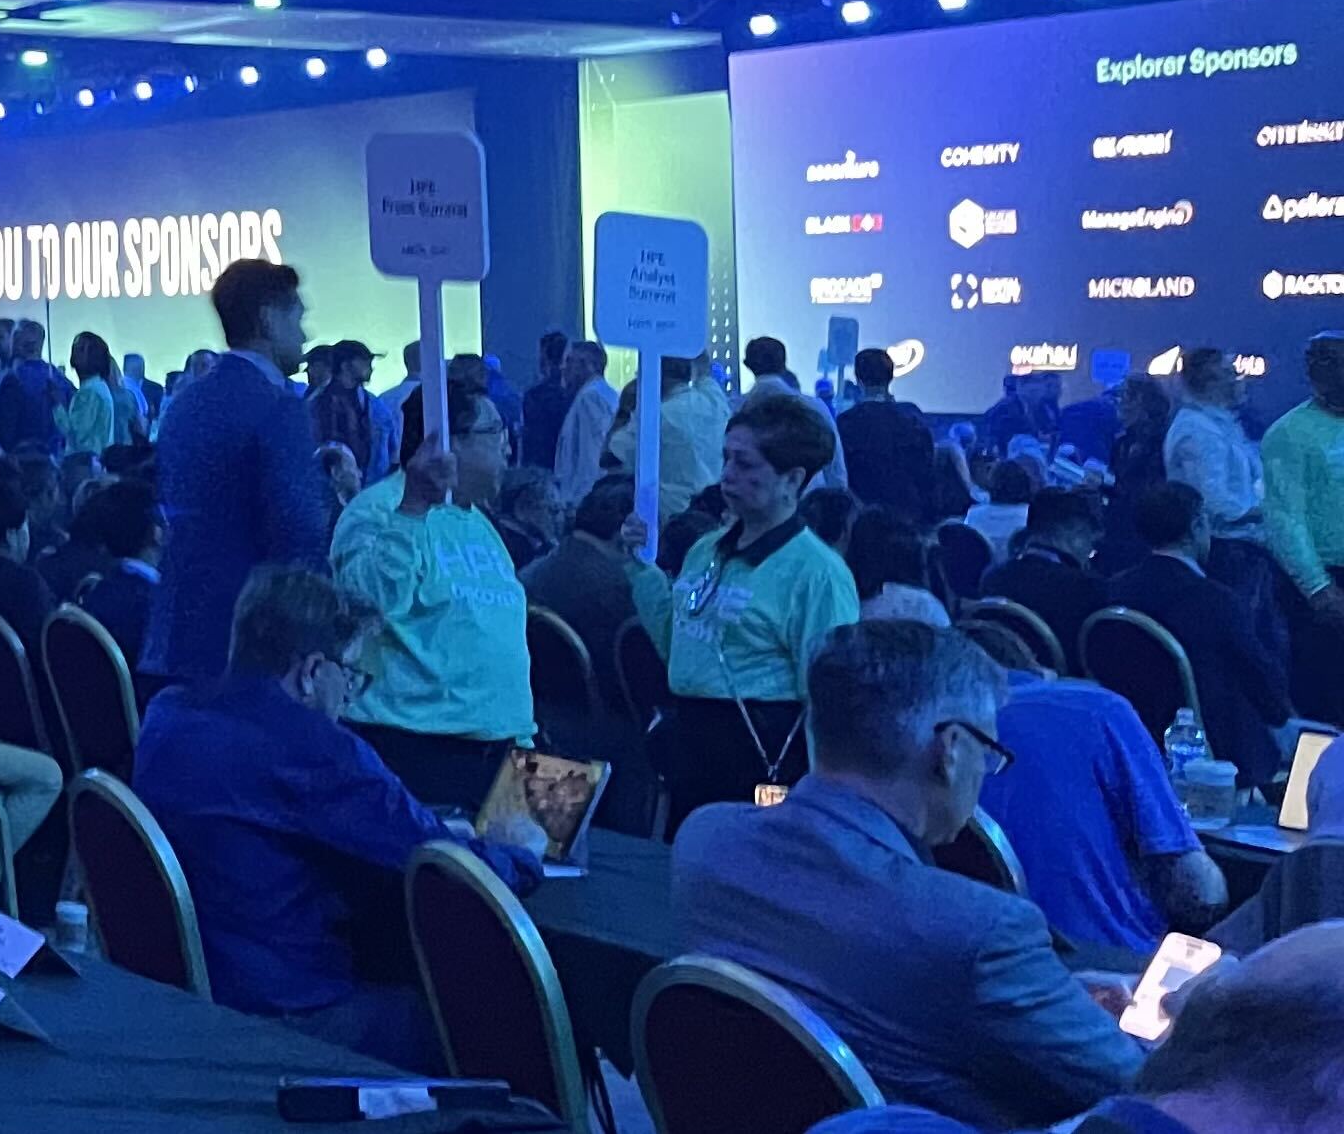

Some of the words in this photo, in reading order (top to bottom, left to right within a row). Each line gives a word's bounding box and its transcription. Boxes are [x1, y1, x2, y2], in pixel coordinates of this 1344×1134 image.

[1096, 52, 1186, 86] Explorer
[1189, 42, 1298, 78] Sponsors
[26, 223, 60, 301] TO
[63, 220, 121, 299] OUR
[122, 208, 283, 298] SPONSORS
[1088, 276, 1196, 298] MICROLAND
